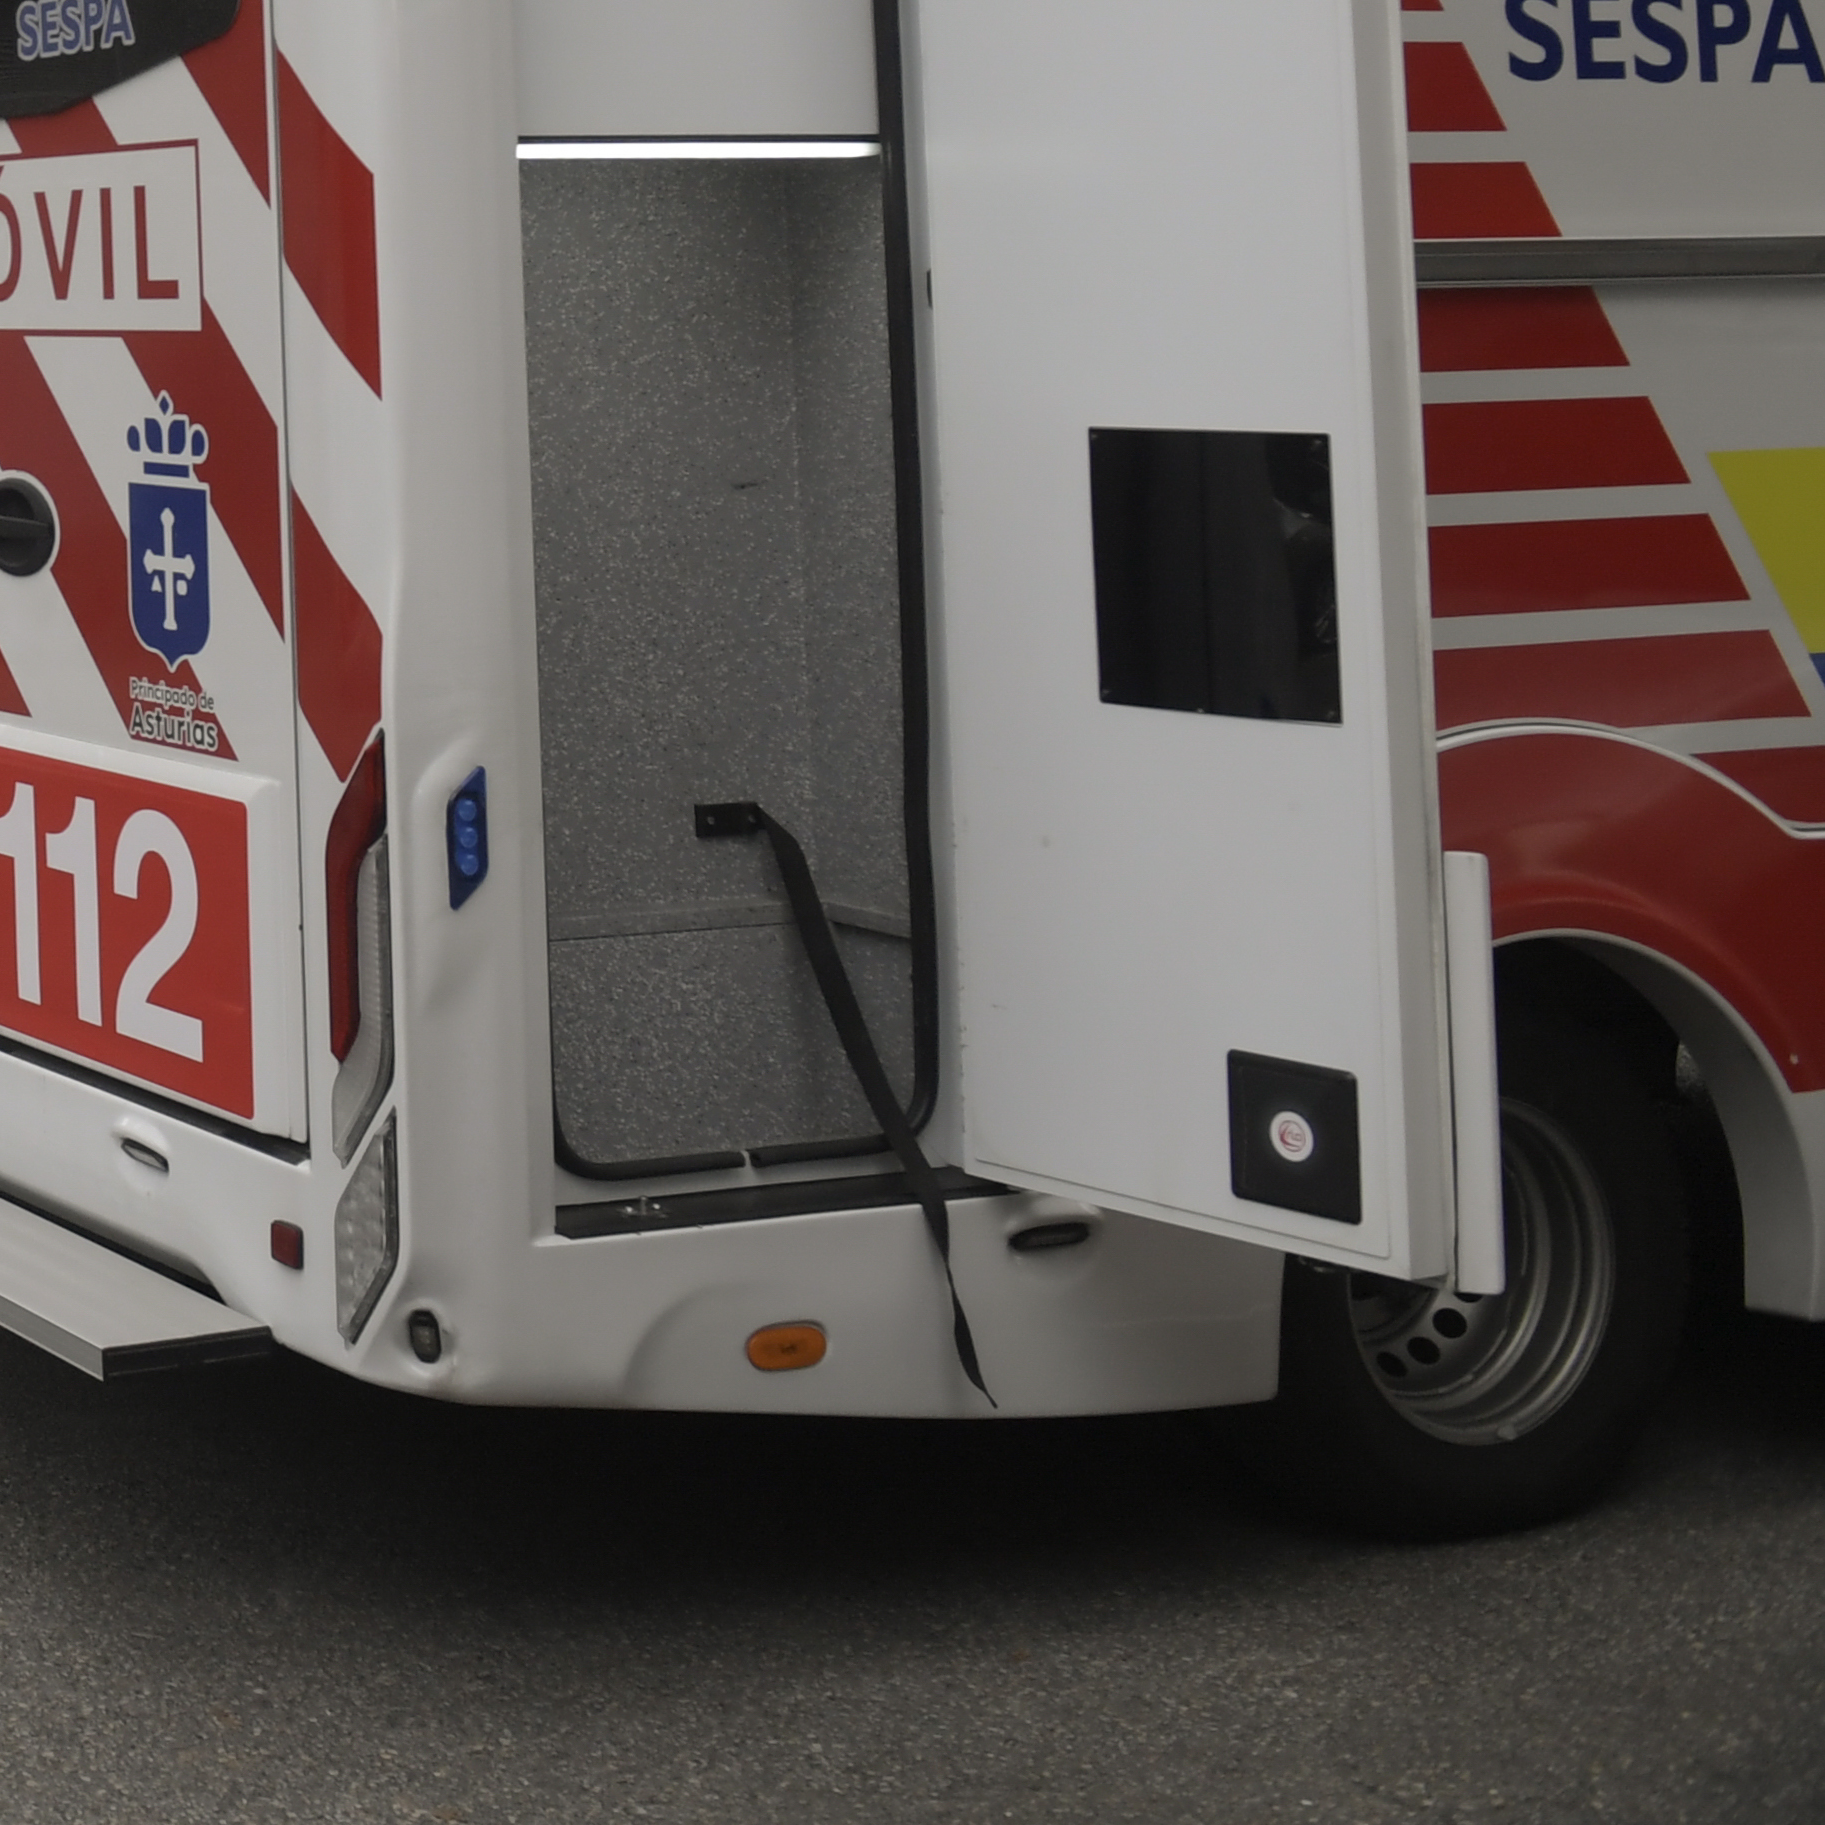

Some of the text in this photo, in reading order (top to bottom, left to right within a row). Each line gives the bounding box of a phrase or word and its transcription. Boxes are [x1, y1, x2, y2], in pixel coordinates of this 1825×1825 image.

[131, 679, 215, 711] Principado de
[131, 704, 217, 749] Asturias
